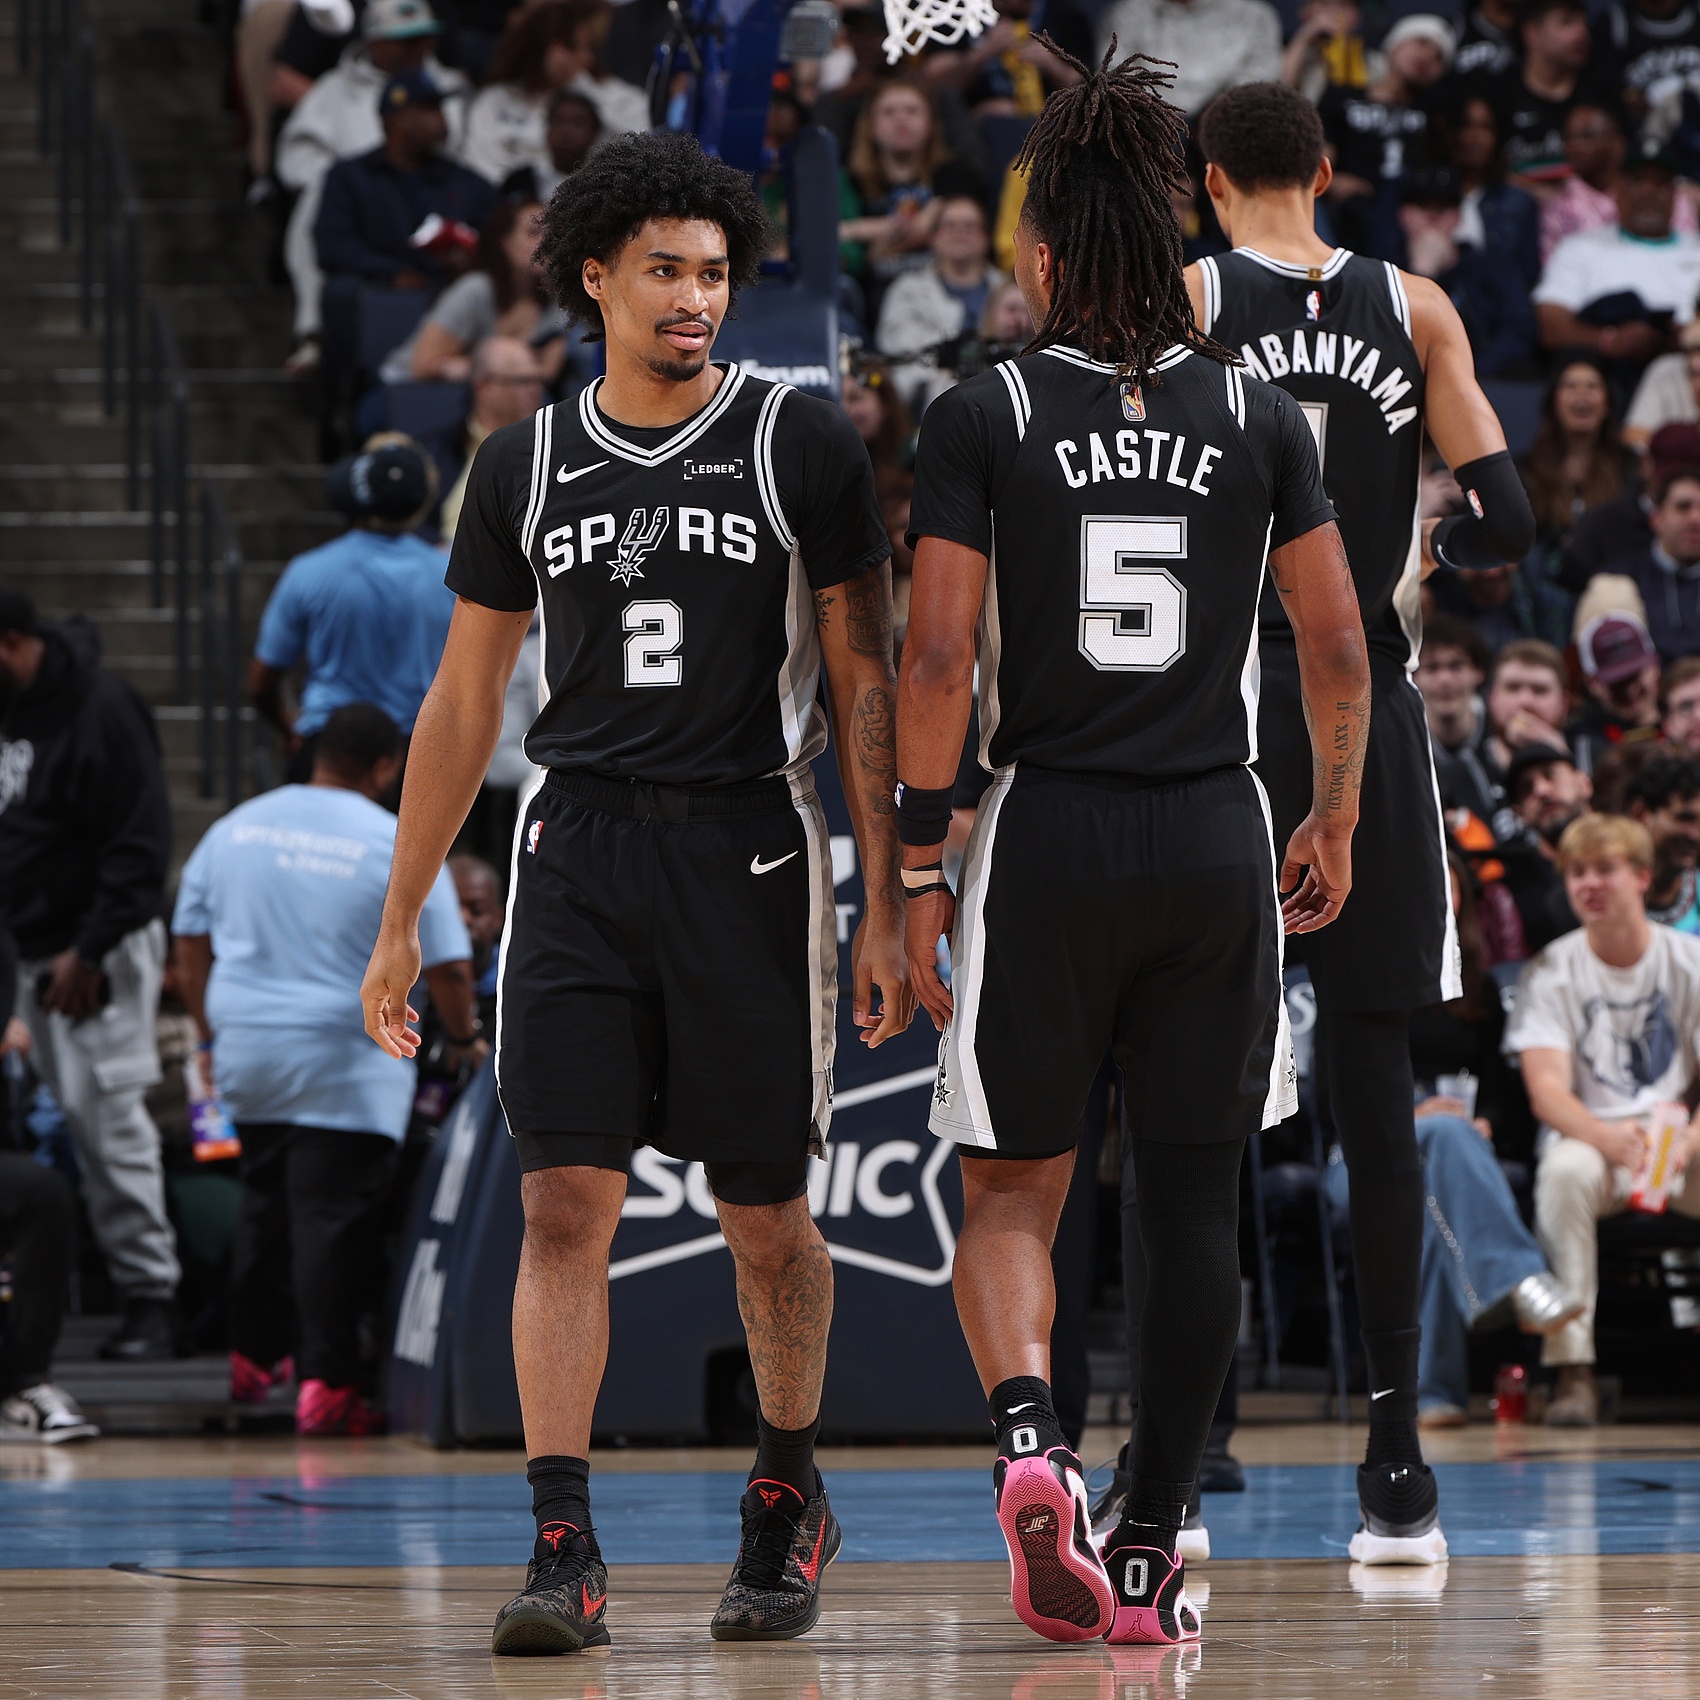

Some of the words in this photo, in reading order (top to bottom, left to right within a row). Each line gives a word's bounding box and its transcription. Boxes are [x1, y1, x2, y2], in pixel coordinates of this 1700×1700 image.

[691, 464, 736, 475] LEDGER
[1054, 428, 1224, 497] CASTLE
[543, 506, 757, 587] SPURS
[1077, 514, 1188, 672] 5
[621, 598, 683, 688] 2
[1334, 723, 1349, 751] XXV
[620, 1139, 921, 1219] SIC
[1012, 1426, 1039, 1454] 0
[1124, 1557, 1149, 1597] 0
